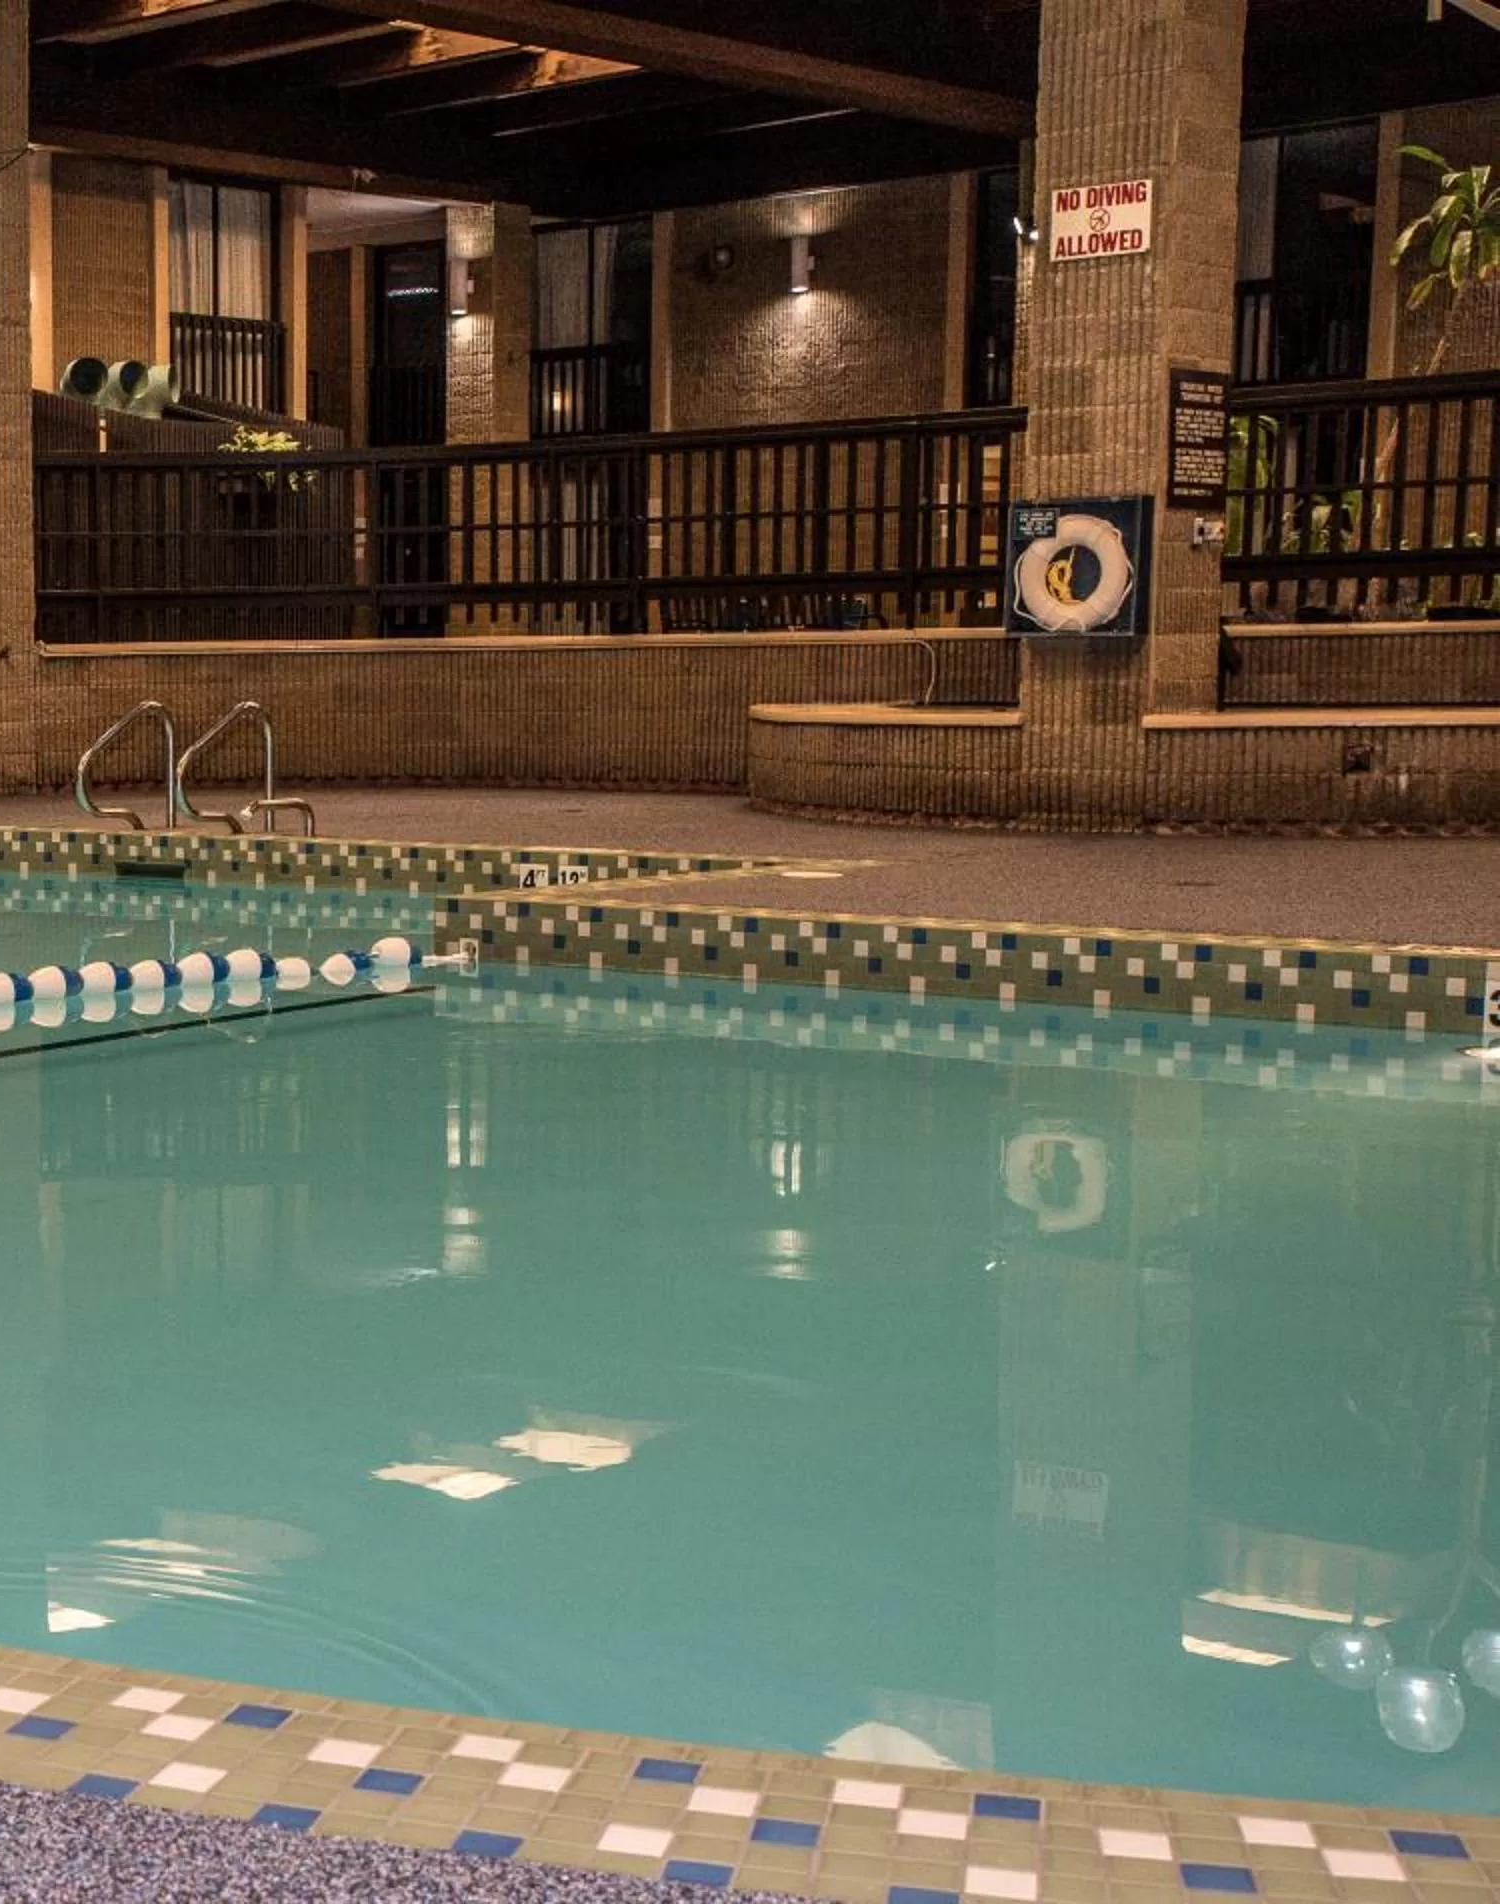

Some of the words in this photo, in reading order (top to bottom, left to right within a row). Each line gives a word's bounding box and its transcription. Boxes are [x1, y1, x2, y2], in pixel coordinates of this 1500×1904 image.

[1056, 190, 1080, 213] NO
[1086, 182, 1148, 209] DIVING
[1055, 229, 1143, 258] ALLOWED
[522, 869, 536, 888] 4
